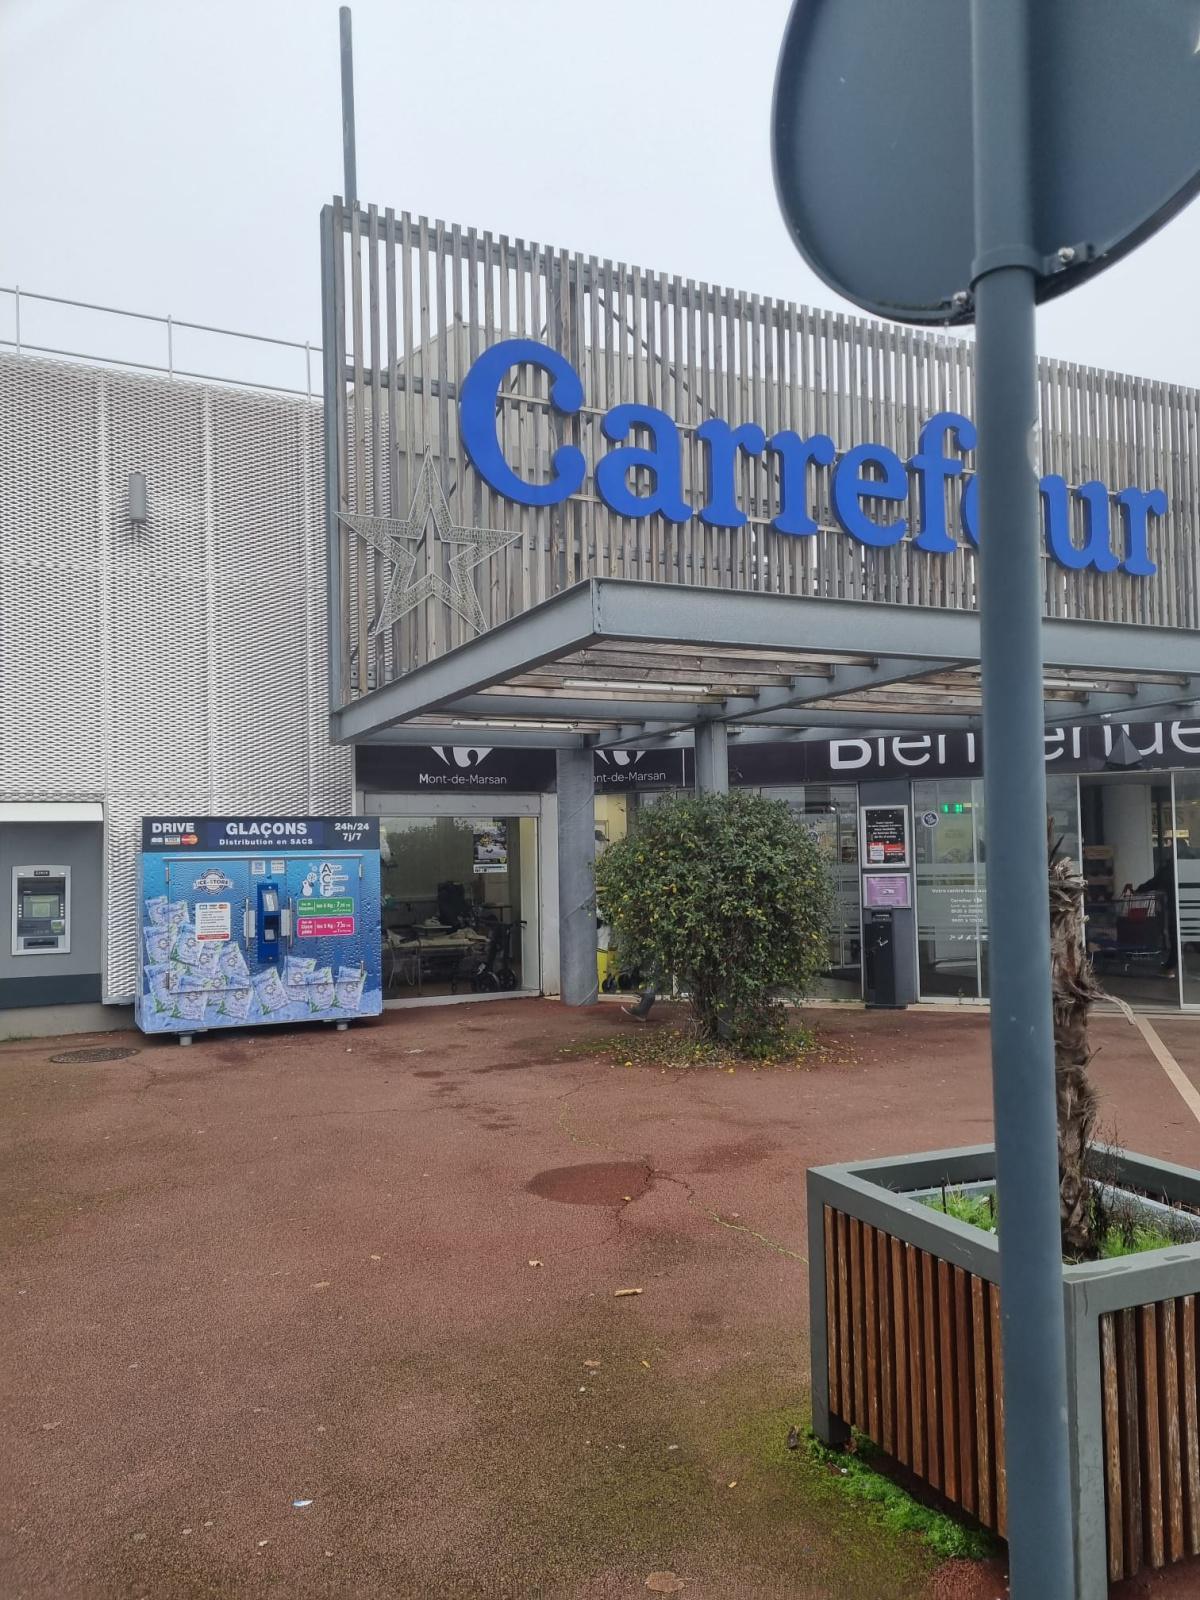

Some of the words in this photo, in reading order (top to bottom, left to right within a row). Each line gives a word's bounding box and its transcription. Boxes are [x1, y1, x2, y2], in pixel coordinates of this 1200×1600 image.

[460, 339, 1167, 576] Carrefur
[419, 774, 507, 785] Mont-de-Marsan
[592, 771, 666, 783] ont-de-Marsan
[152, 822, 195, 833] DRIVE
[226, 822, 308, 838] GLAÇONS
[334, 823, 370, 831] 24h/24
[219, 838, 273, 846] Distribution
[343, 833, 362, 842] 7j/7
